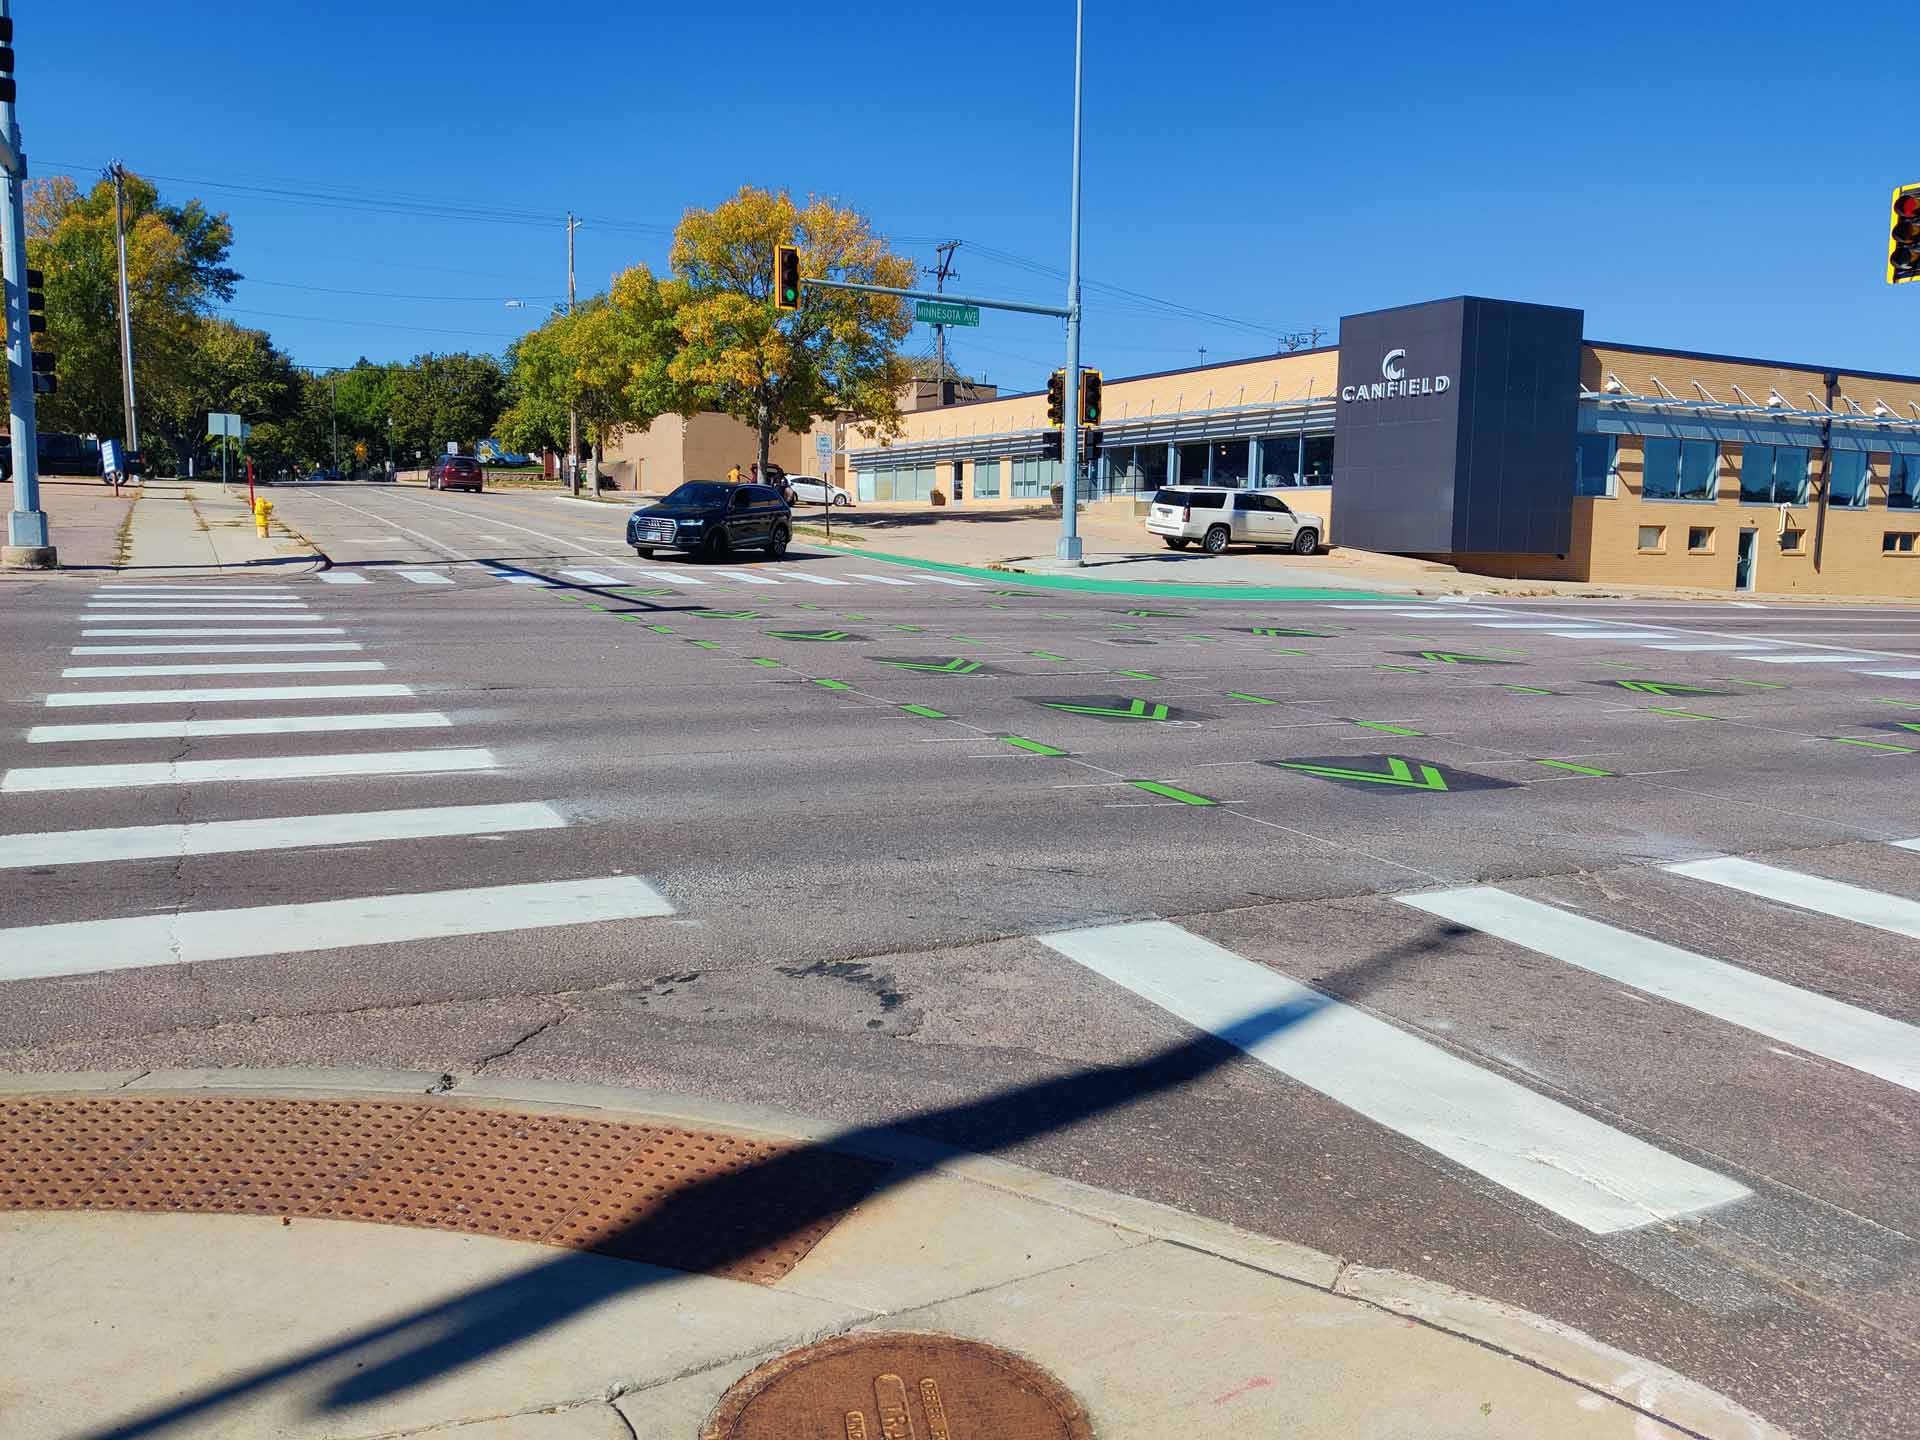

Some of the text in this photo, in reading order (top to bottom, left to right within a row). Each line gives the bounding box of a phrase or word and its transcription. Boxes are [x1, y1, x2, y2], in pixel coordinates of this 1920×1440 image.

[917, 304, 978, 322] MINNESOTA AVE
[1342, 375, 1450, 401] CANFIELD
